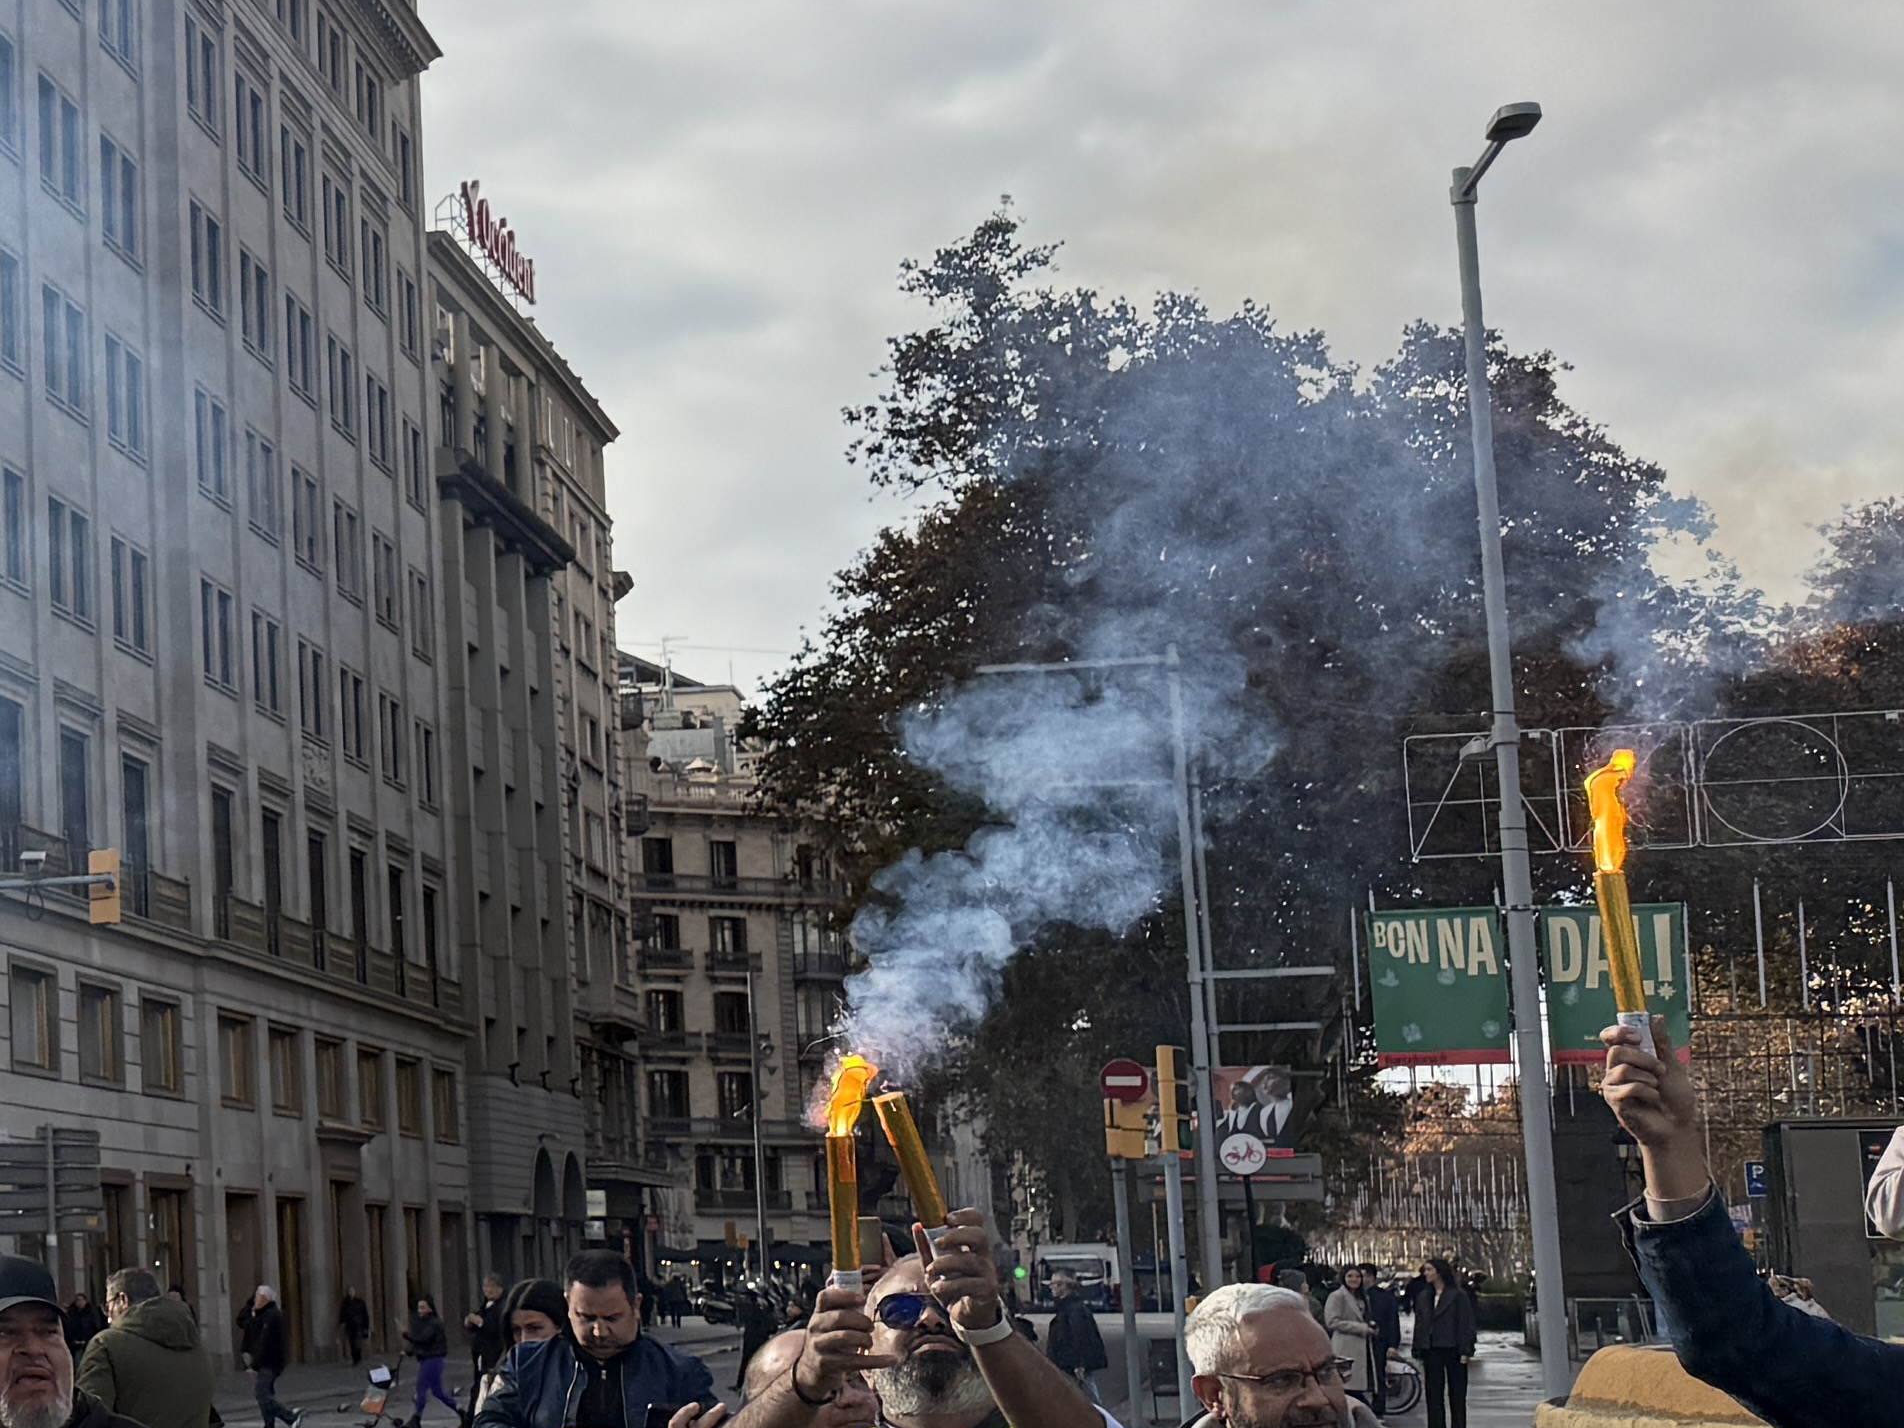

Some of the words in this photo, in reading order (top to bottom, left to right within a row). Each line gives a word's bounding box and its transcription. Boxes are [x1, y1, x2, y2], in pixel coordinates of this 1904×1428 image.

[1373, 919, 1430, 964] BON
[1436, 916, 1498, 976] NA
[1751, 1164, 1765, 1179] P
